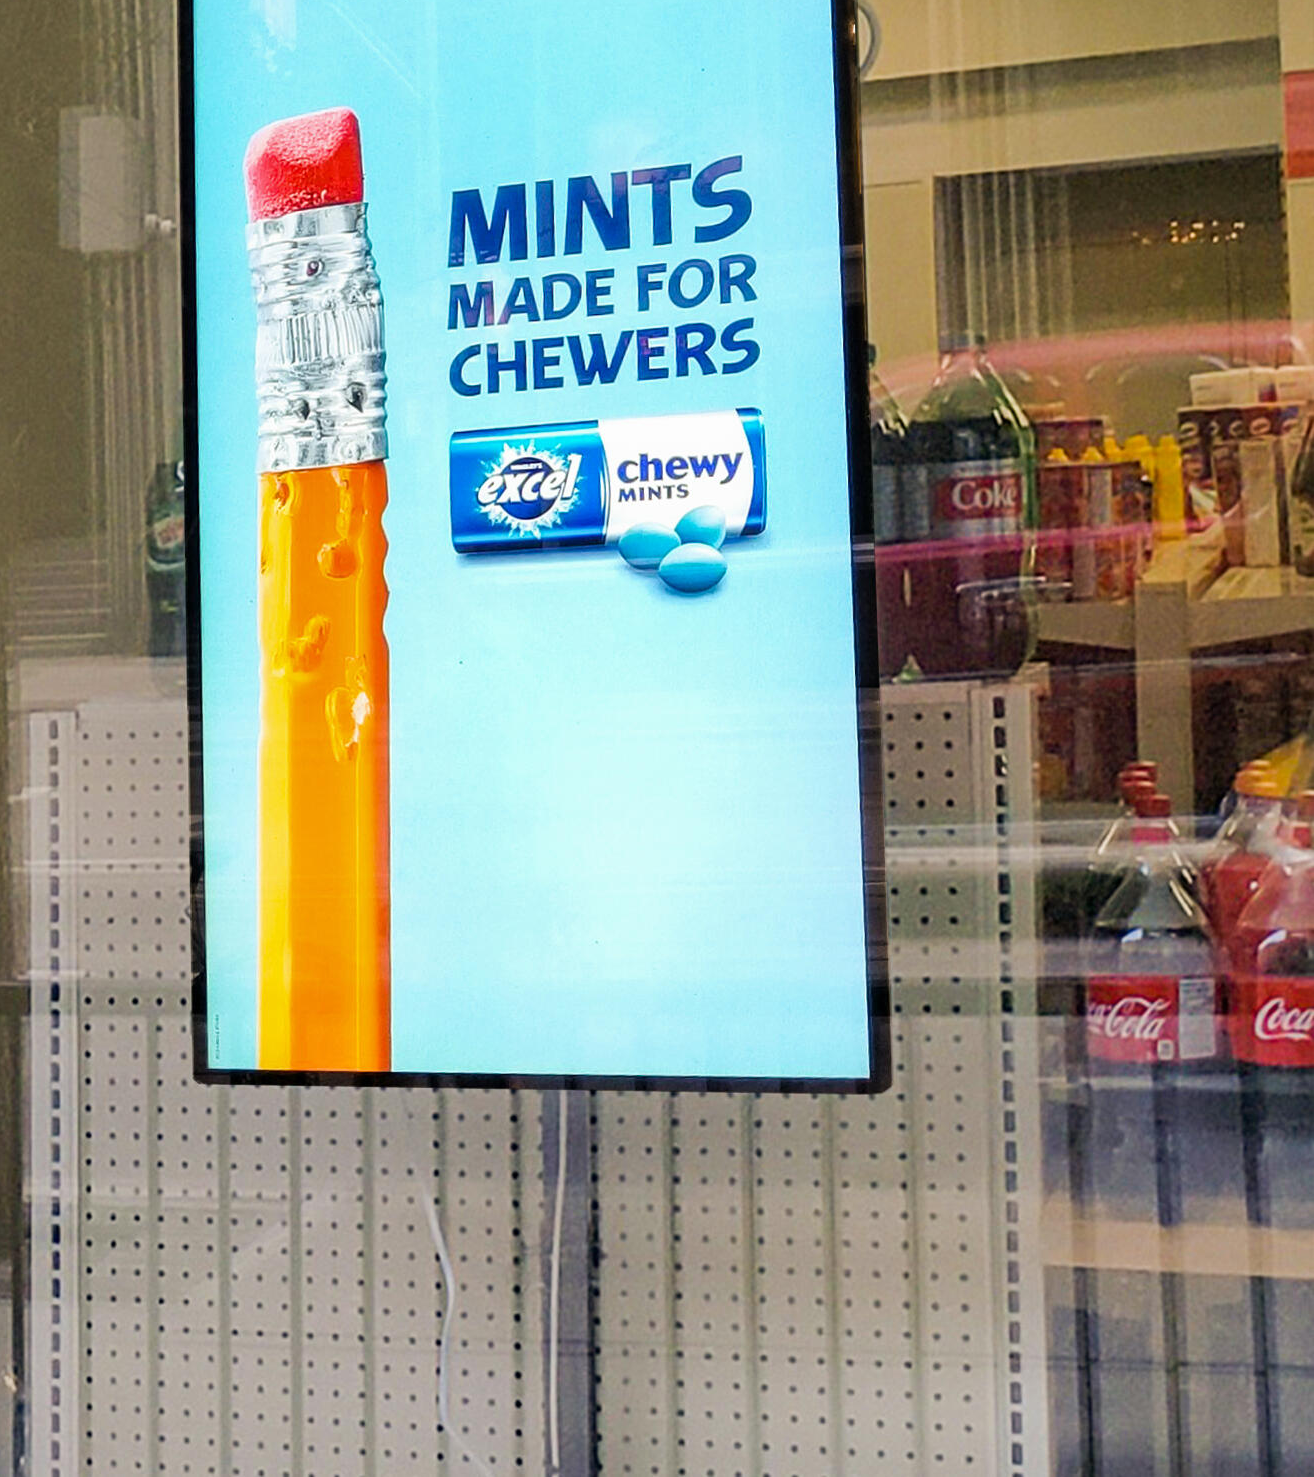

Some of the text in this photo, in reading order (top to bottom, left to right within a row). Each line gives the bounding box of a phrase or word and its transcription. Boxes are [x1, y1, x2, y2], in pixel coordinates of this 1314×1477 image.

[447, 154, 753, 268] MINTS
[447, 254, 758, 330] MADE FOR
[448, 318, 761, 397] CHEWERS
[477, 452, 744, 506] excel chewy
[617, 484, 690, 503] MINTS
[952, 478, 1018, 511] Coke
